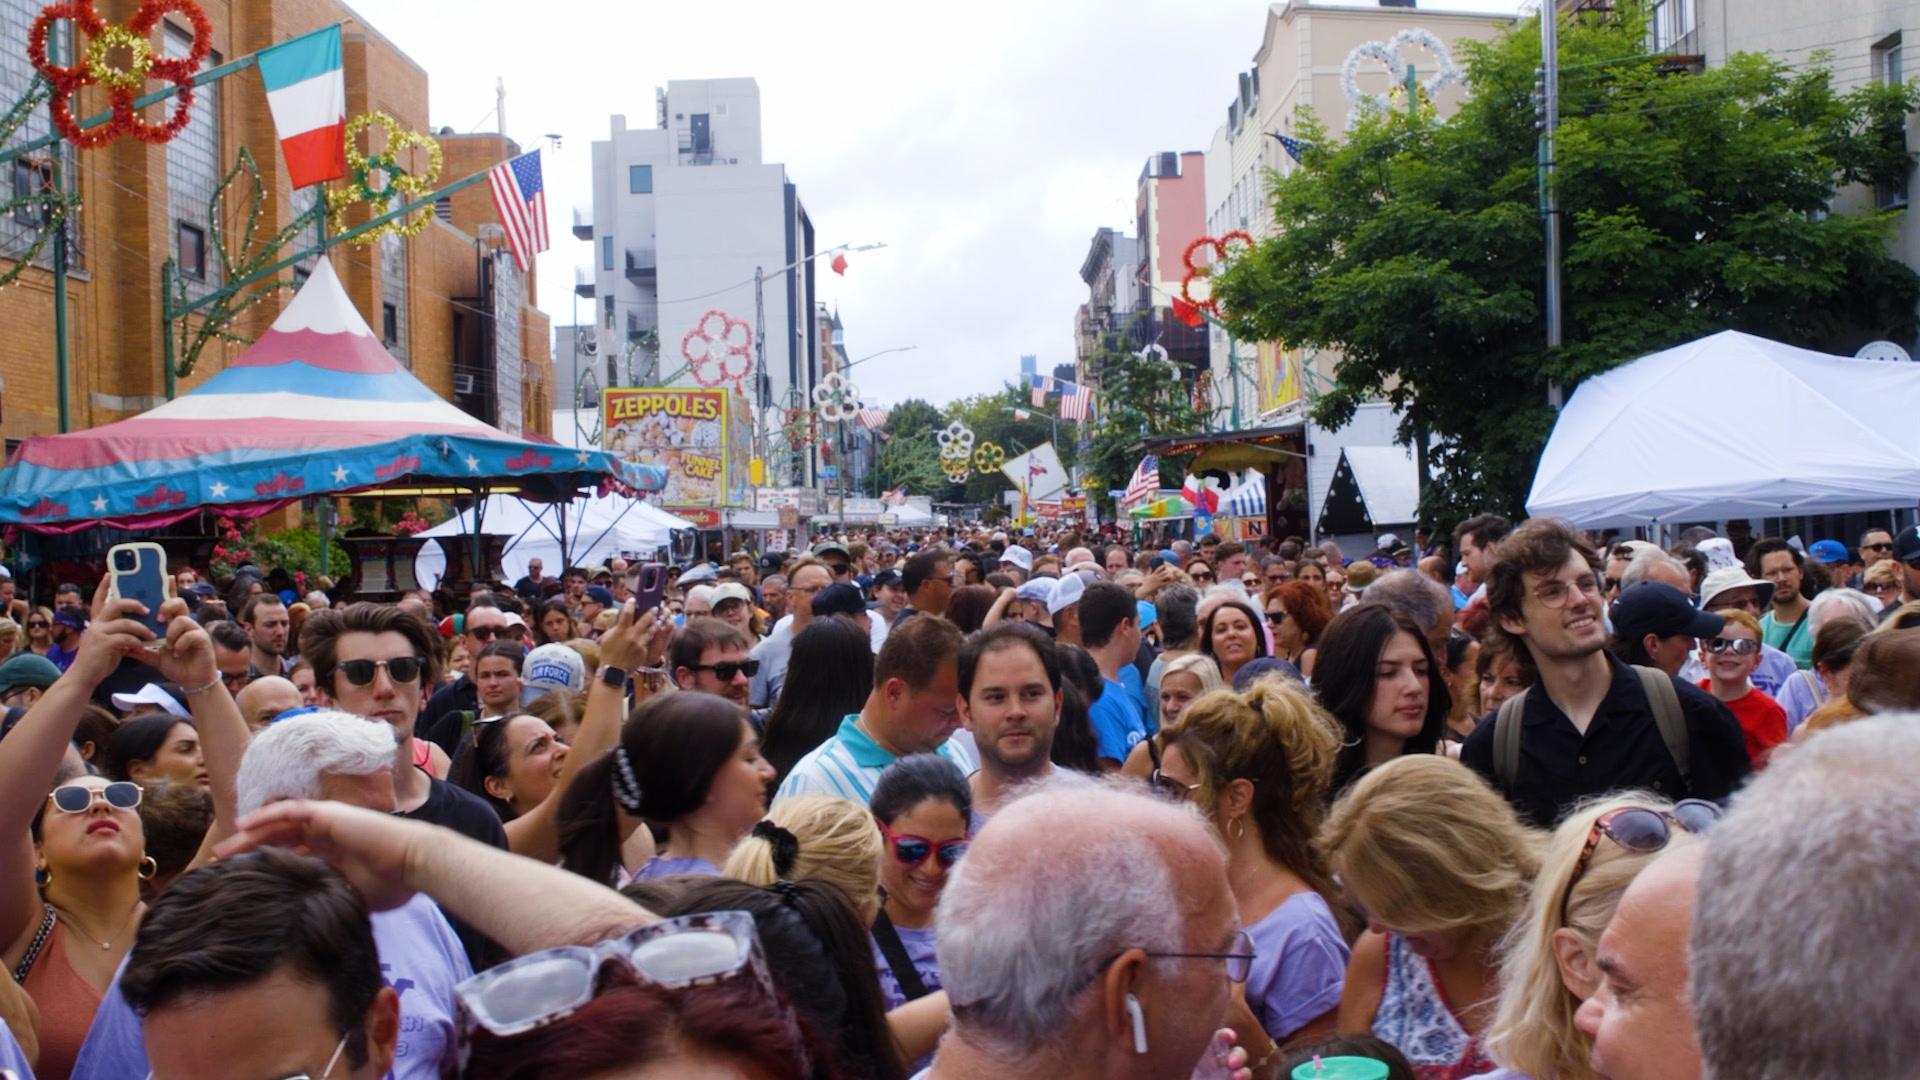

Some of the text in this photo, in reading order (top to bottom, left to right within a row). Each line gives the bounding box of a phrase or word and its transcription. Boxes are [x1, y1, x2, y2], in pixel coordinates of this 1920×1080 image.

[611, 395, 718, 420] ZEPPOLES
[680, 453, 721, 471] FUNNEL
[685, 464, 715, 478] CAKE
[544, 665, 568, 683] FORCE
